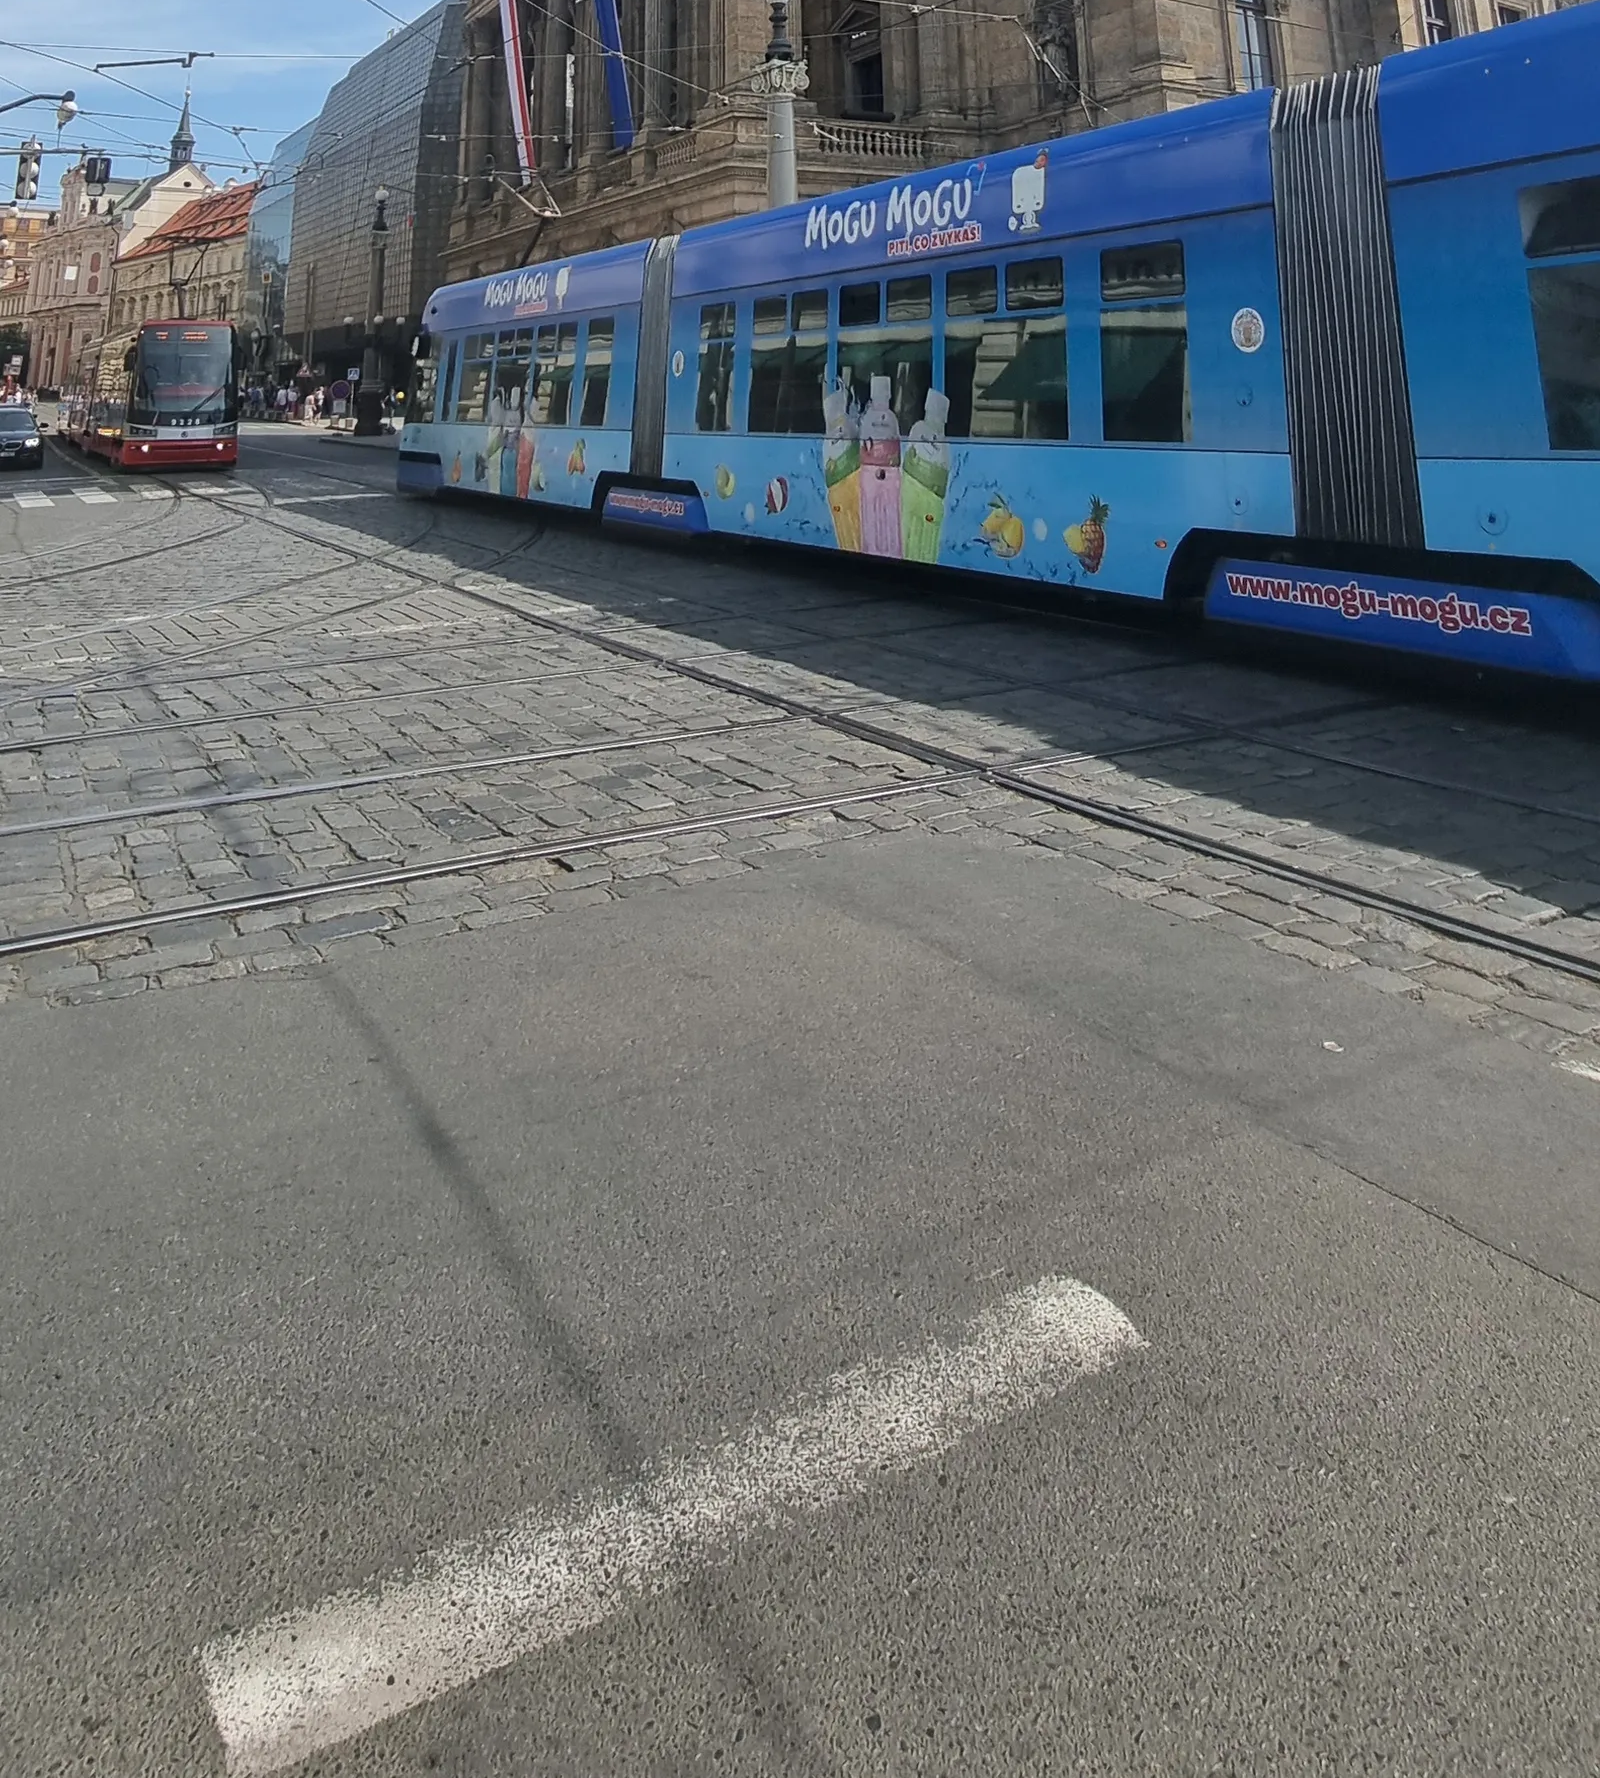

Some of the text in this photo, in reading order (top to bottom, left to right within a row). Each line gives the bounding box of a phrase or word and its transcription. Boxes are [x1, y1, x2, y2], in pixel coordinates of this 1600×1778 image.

[805, 178, 972, 250] MOGU MOGU
[913, 234, 930, 252] CO
[484, 280, 514, 308] MOGU
[515, 272, 548, 305] MOGU
[1226, 572, 1532, 637] www.mogu-mogu.cz
